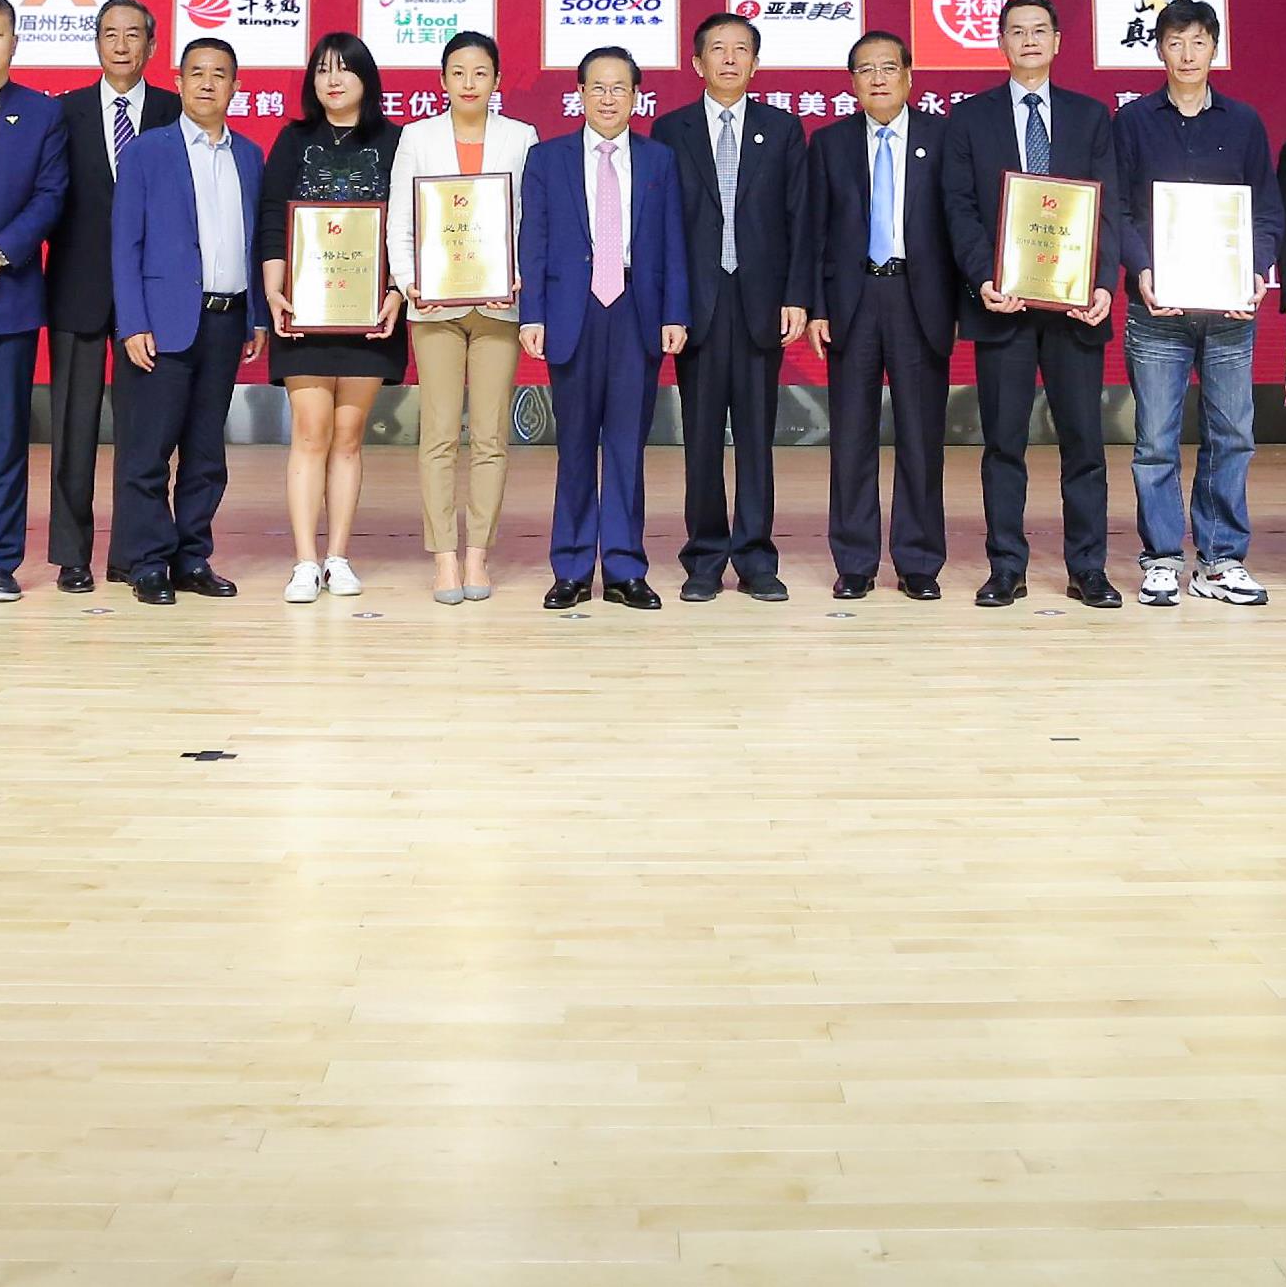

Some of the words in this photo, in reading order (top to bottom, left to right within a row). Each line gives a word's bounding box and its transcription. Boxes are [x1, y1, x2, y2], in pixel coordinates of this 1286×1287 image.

[764, 1, 855, 20] 亚惠美食
[18, 15, 97, 31] 眉州东坡
[416, 13, 458, 26] food
[18, 34, 56, 42] EIZHOU
[226, 91, 284, 116] 喜鹤
